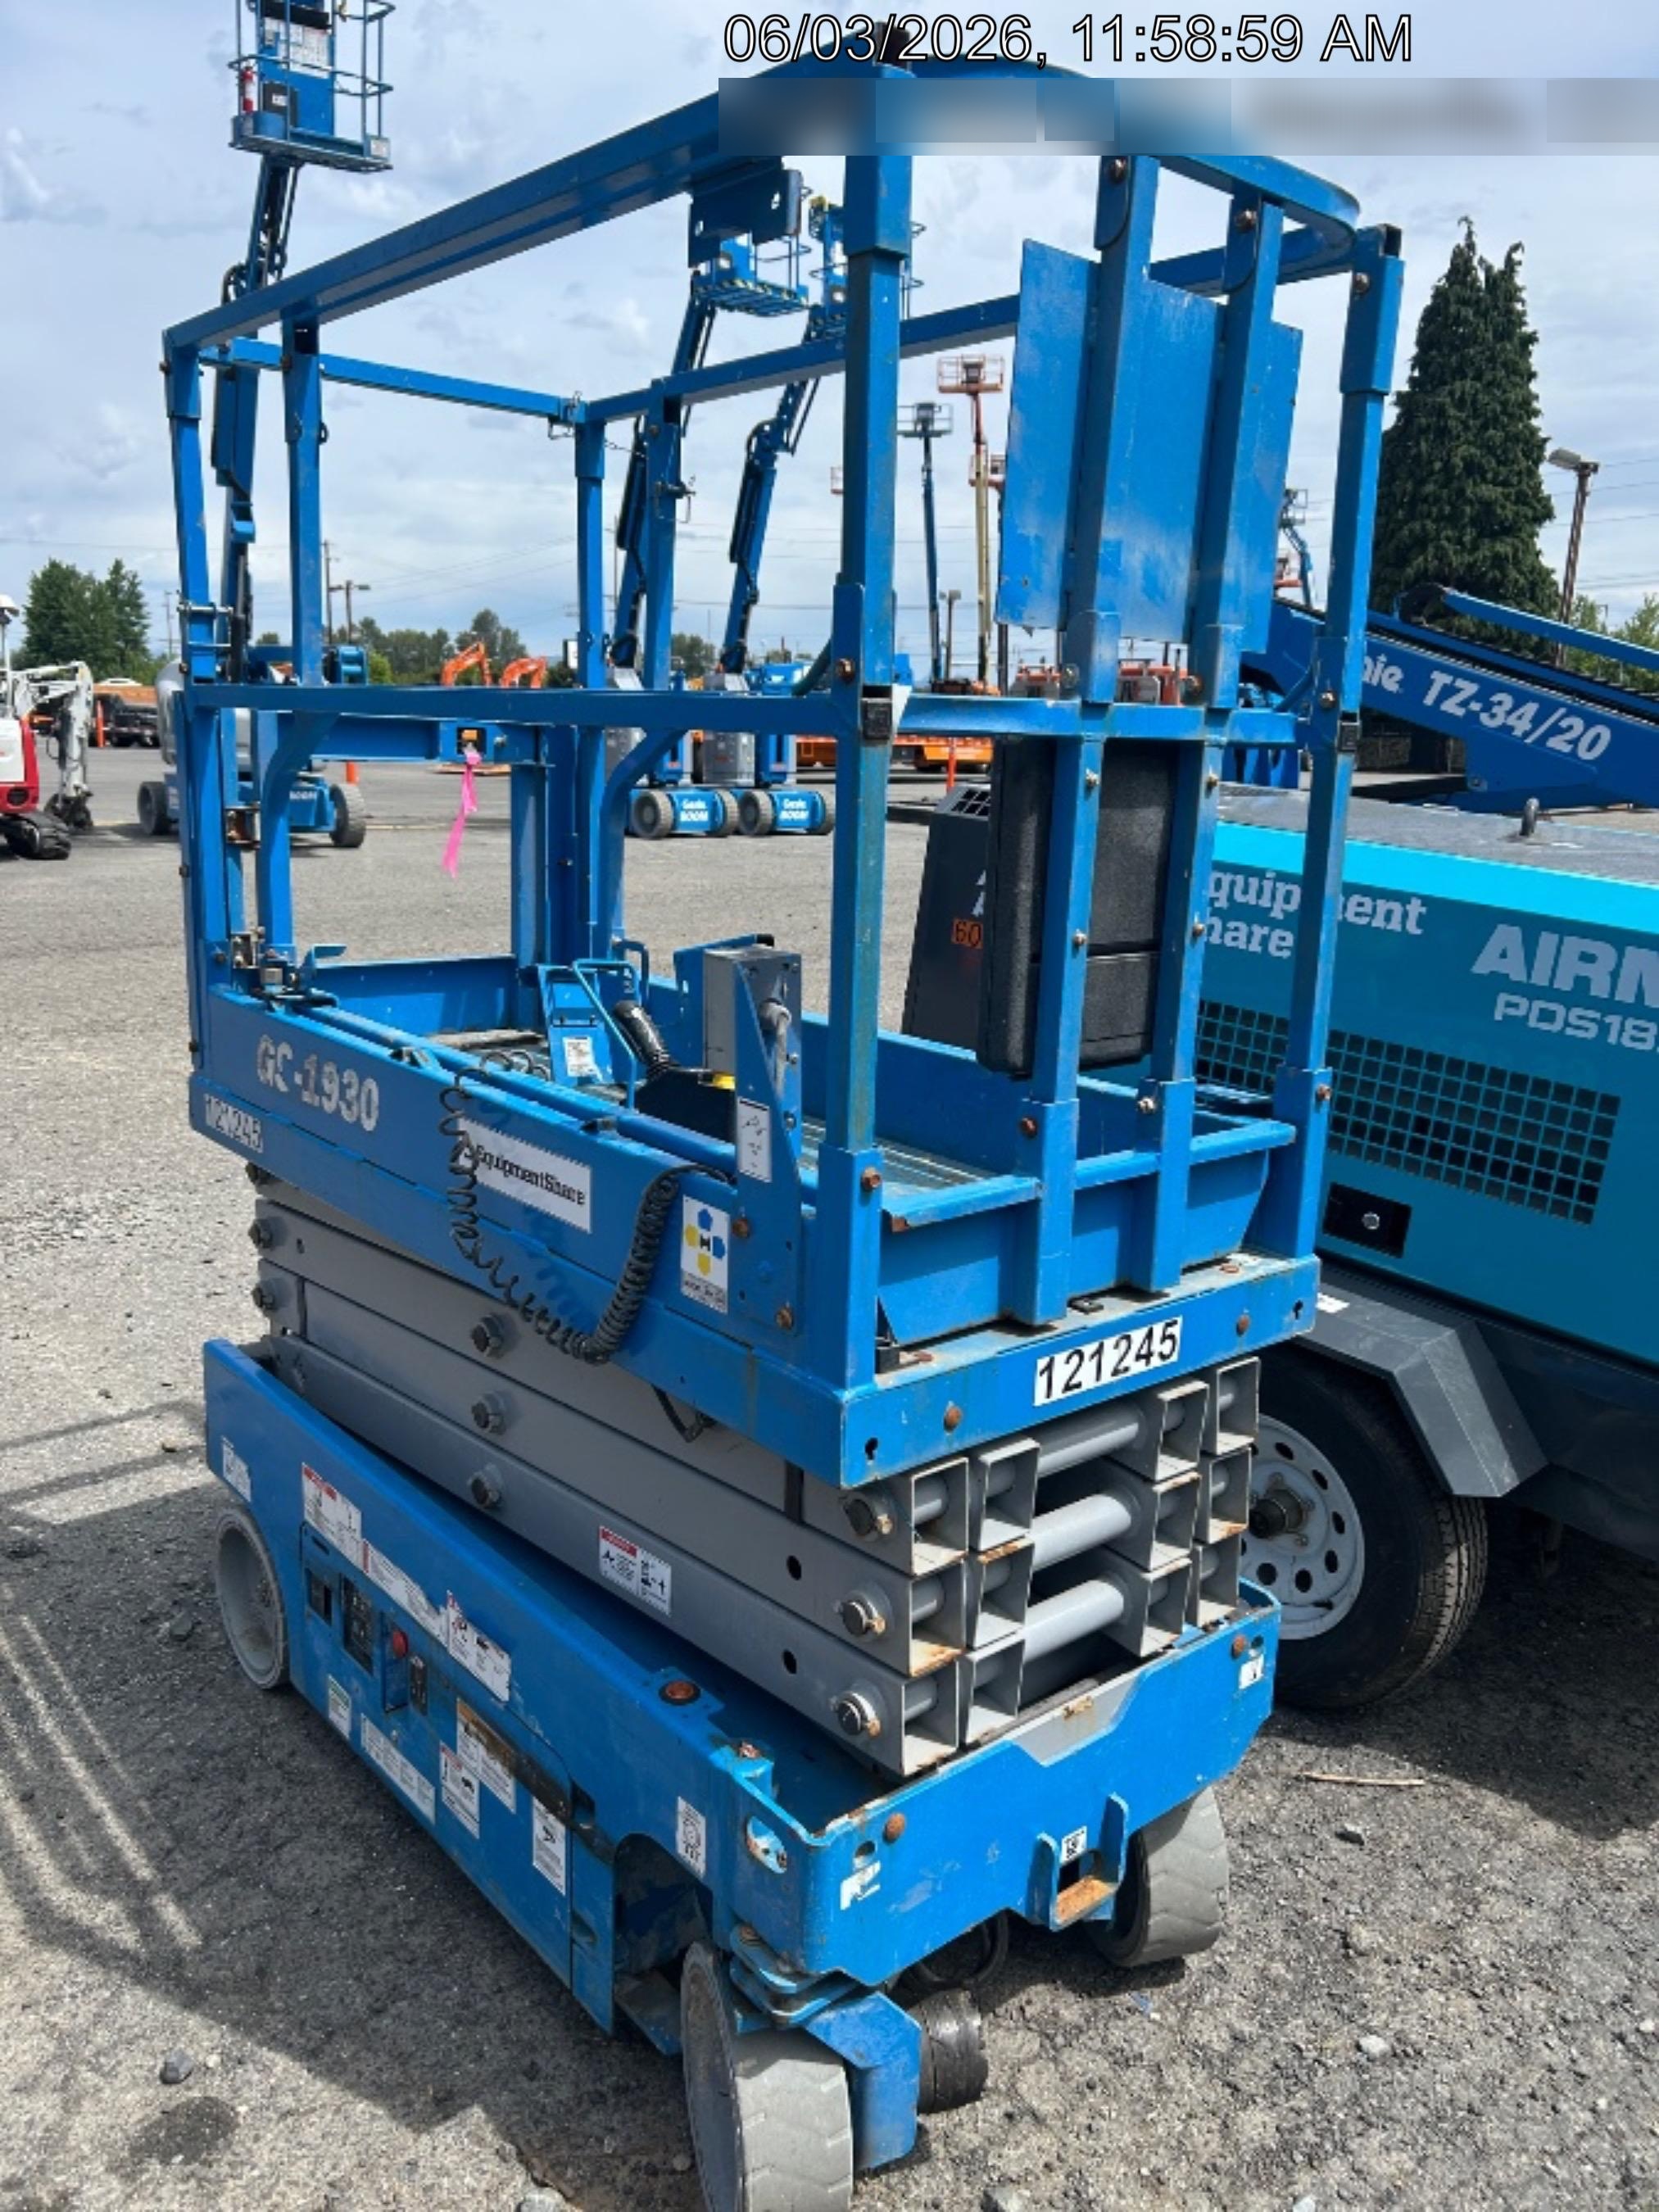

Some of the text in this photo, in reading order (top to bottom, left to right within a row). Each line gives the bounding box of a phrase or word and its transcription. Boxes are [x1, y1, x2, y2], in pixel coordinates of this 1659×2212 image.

[1362, 654, 1611, 760] nie TZ-34/20
[1204, 907, 1294, 959] hare
[1209, 869, 1427, 935] quipent
[1494, 992, 1659, 1053] PDS18
[1039, 1320, 1178, 1399] 121245
